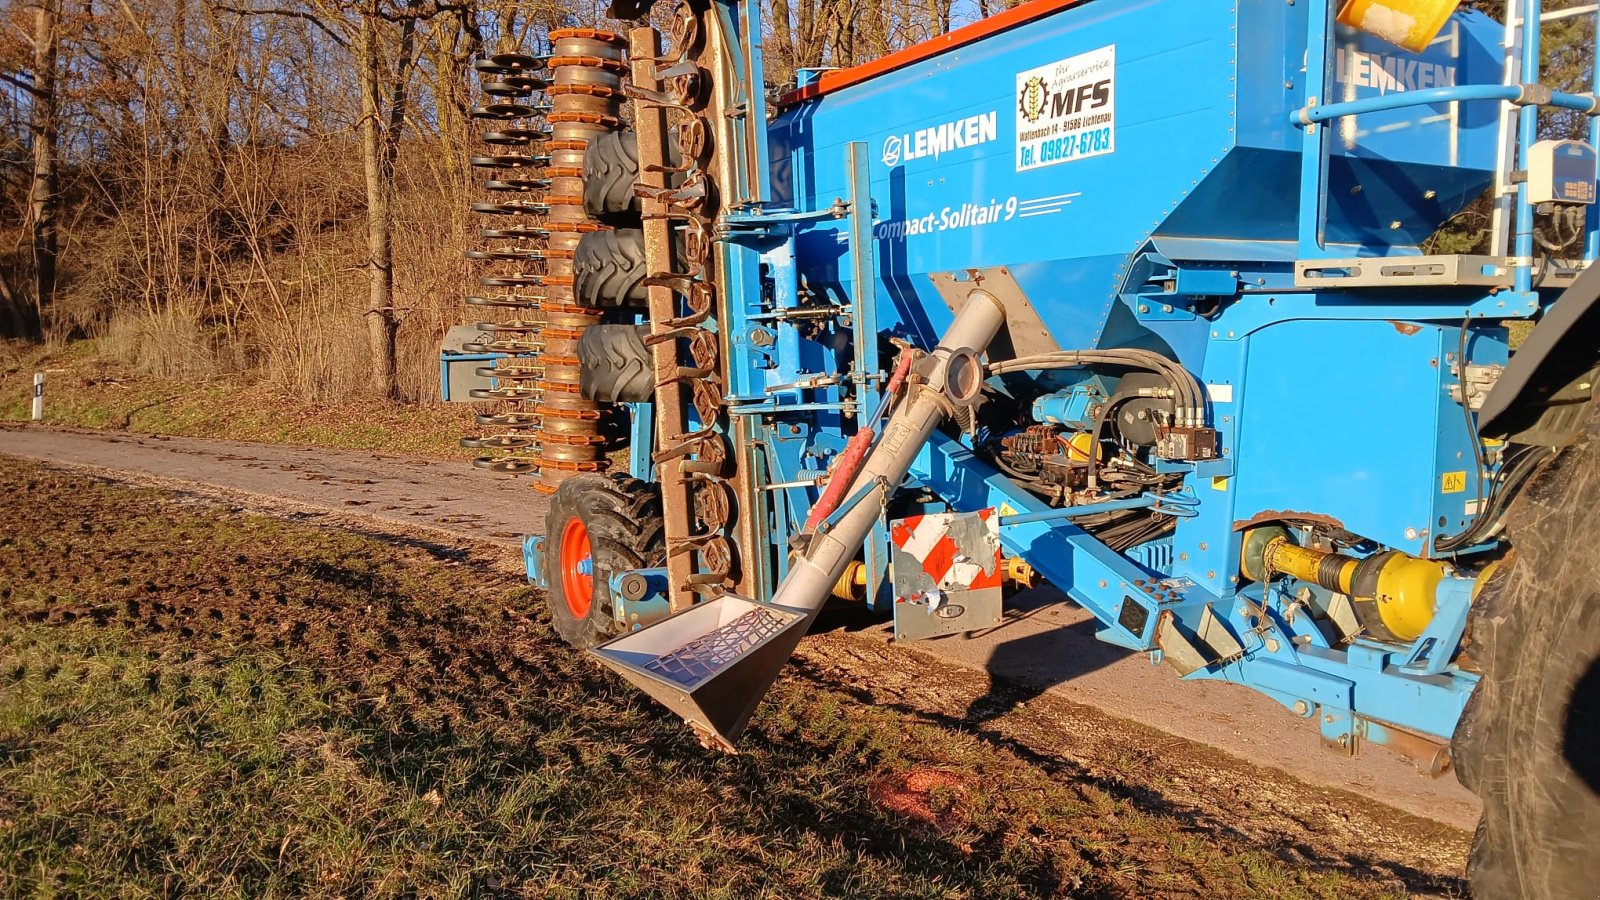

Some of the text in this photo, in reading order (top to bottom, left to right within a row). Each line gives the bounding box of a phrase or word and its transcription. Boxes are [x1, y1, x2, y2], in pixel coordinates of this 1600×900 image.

[1051, 59, 1110, 92] Agrarservice
[1055, 64, 1070, 77] Ihr
[1336, 48, 1456, 97] LEMKEN
[1050, 79, 1111, 119] MFS
[903, 110, 997, 161] LEMKEN
[1052, 123, 1058, 135] 14
[1082, 112, 1111, 128] Lichtenau
[1020, 127, 1111, 167] Tel. 09827-6783
[872, 196, 1018, 242] Compact-Solitair 9
